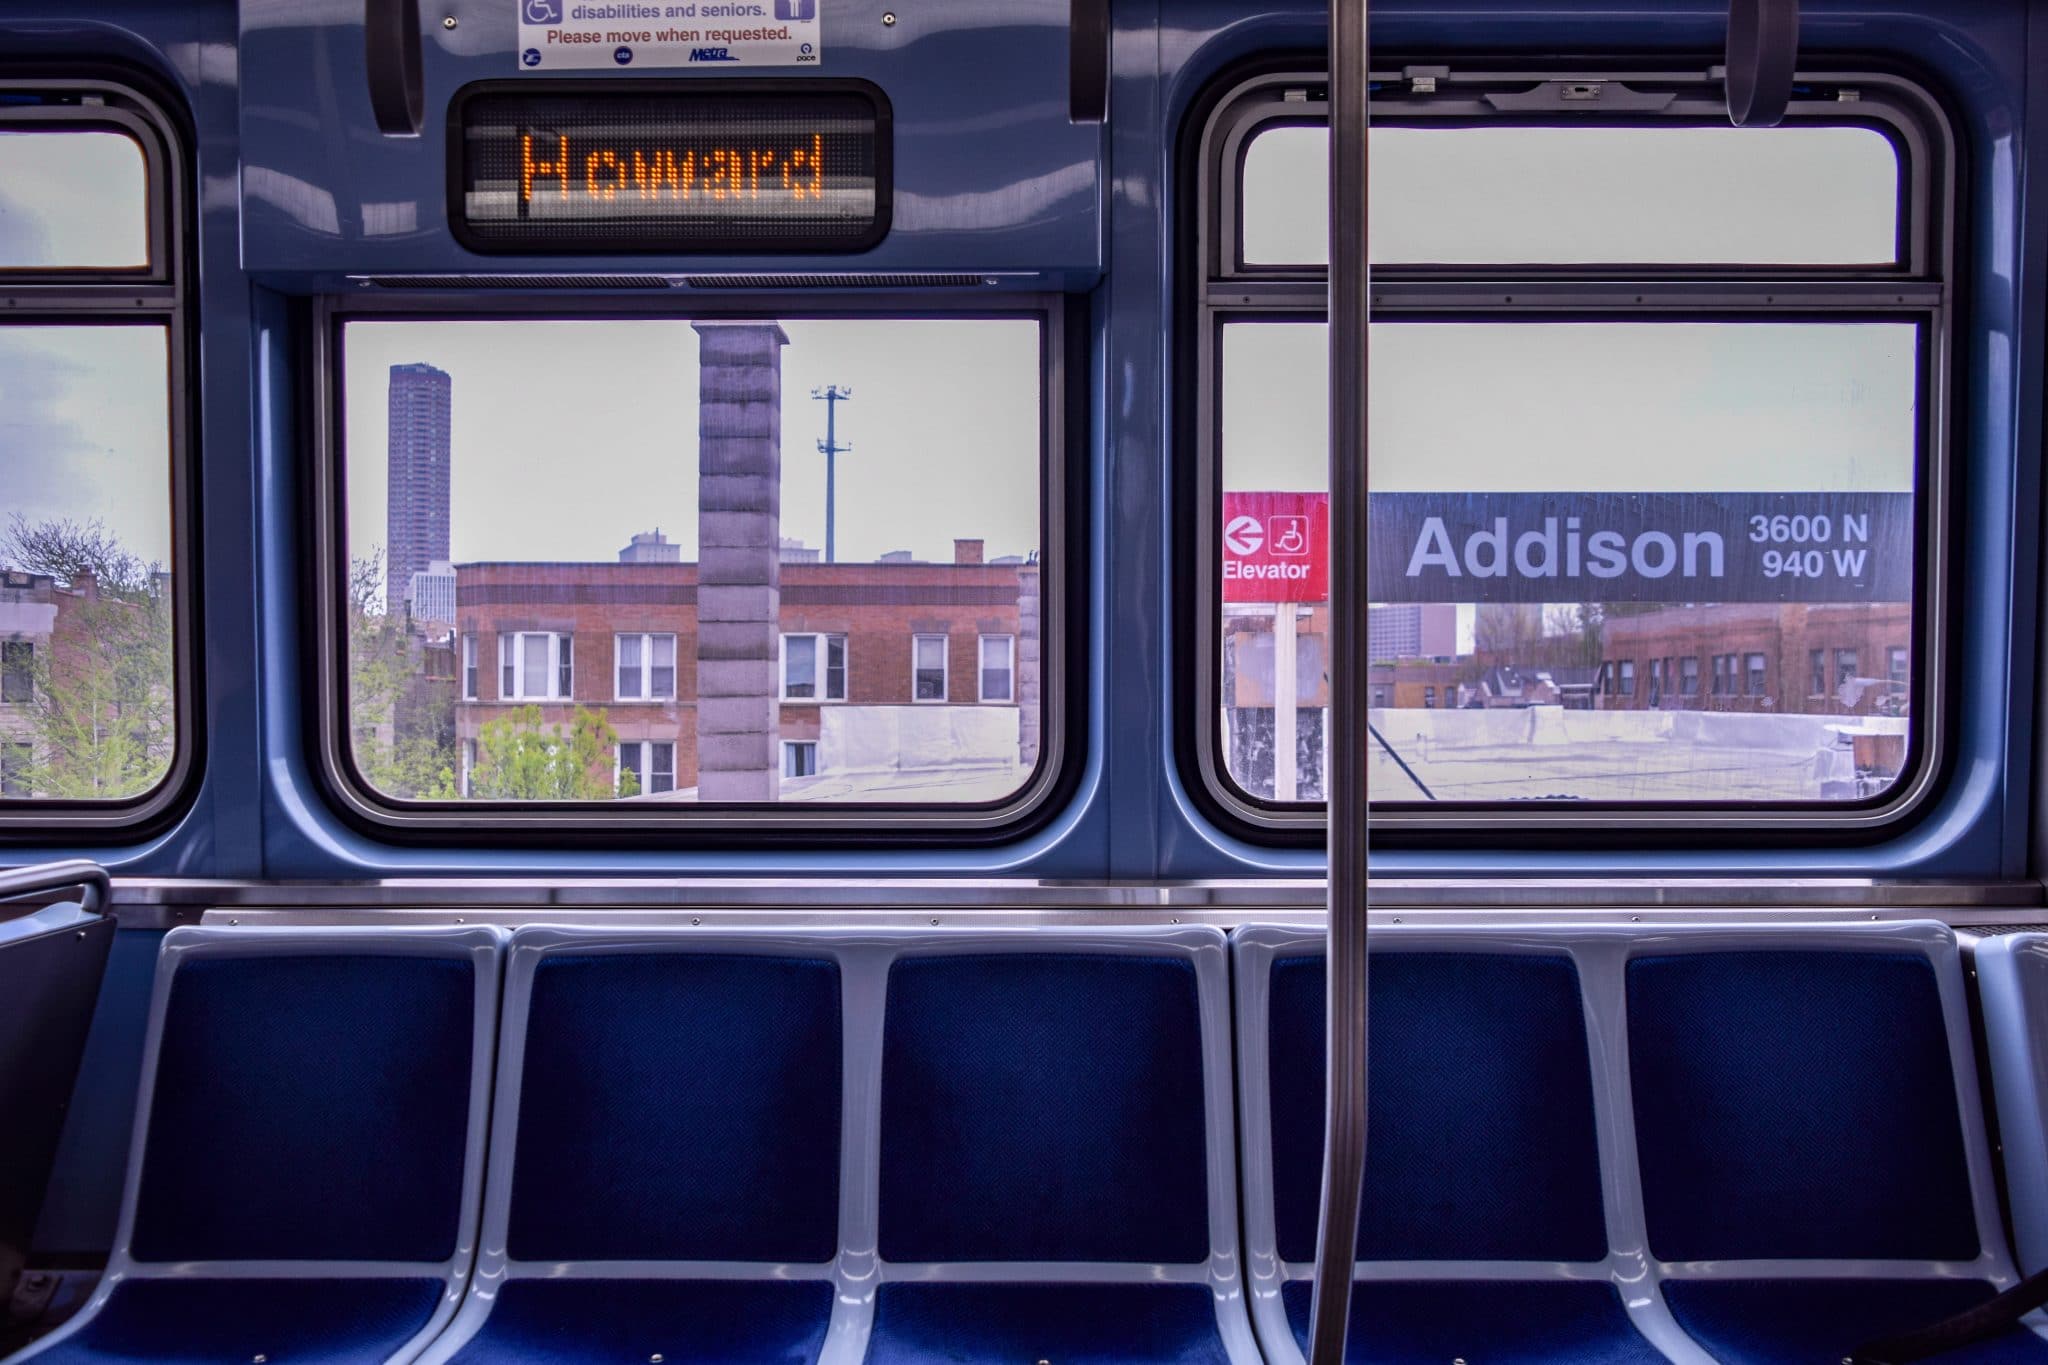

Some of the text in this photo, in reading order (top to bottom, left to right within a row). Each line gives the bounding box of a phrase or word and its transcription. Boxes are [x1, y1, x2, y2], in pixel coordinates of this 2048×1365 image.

[571, 3, 767, 19] disabilities and seniors.
[547, 26, 792, 44] Please move when requested.
[689, 47, 737, 61] Metra
[523, 134, 821, 201] Howard
[1749, 514, 1868, 543] 3600 N
[1406, 516, 1725, 578] Addison
[1223, 560, 1310, 579] Elevator
[1762, 549, 1867, 578] 940 W
